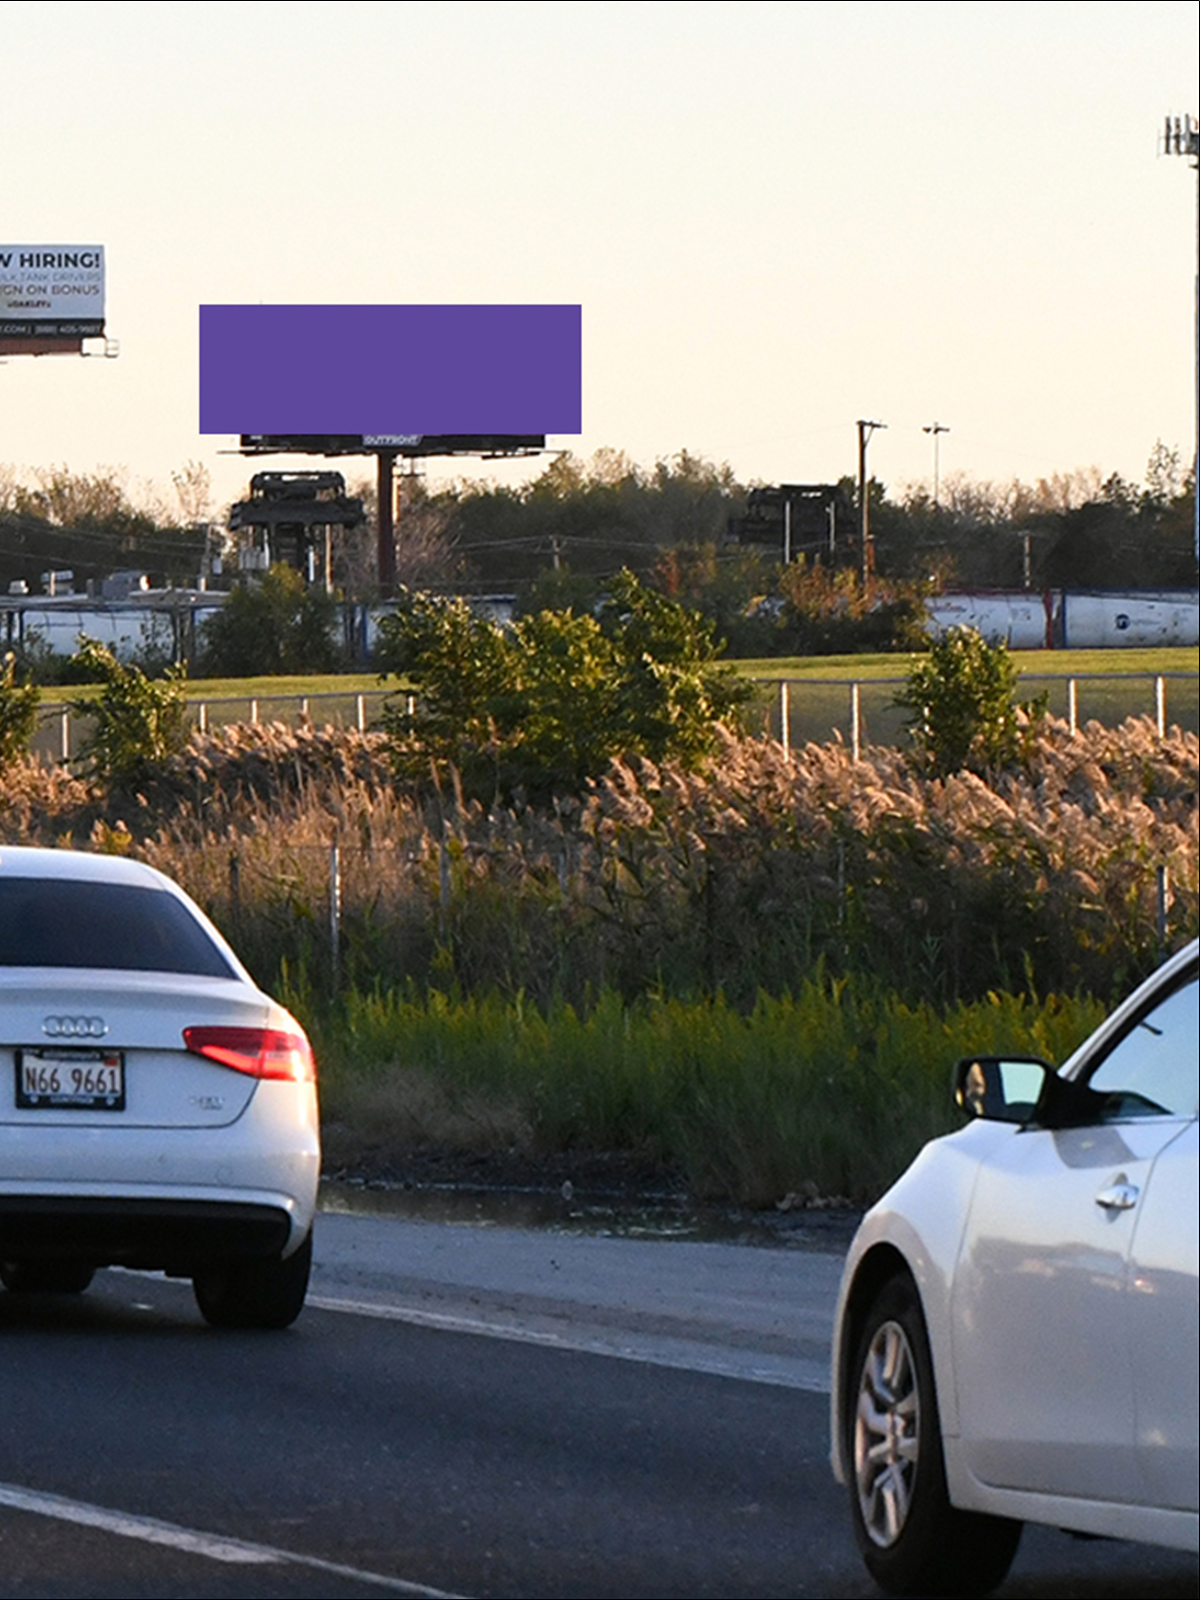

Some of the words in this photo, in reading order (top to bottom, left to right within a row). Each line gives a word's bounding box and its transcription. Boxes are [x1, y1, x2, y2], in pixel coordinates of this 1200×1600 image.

[19, 252, 100, 269] HIRING!
[26, 284, 47, 296] ON
[52, 284, 100, 296] BONUS
[364, 435, 418, 445] OUTFRONT
[25, 1067, 60, 1093] N66
[71, 1068, 119, 1094] 9661
